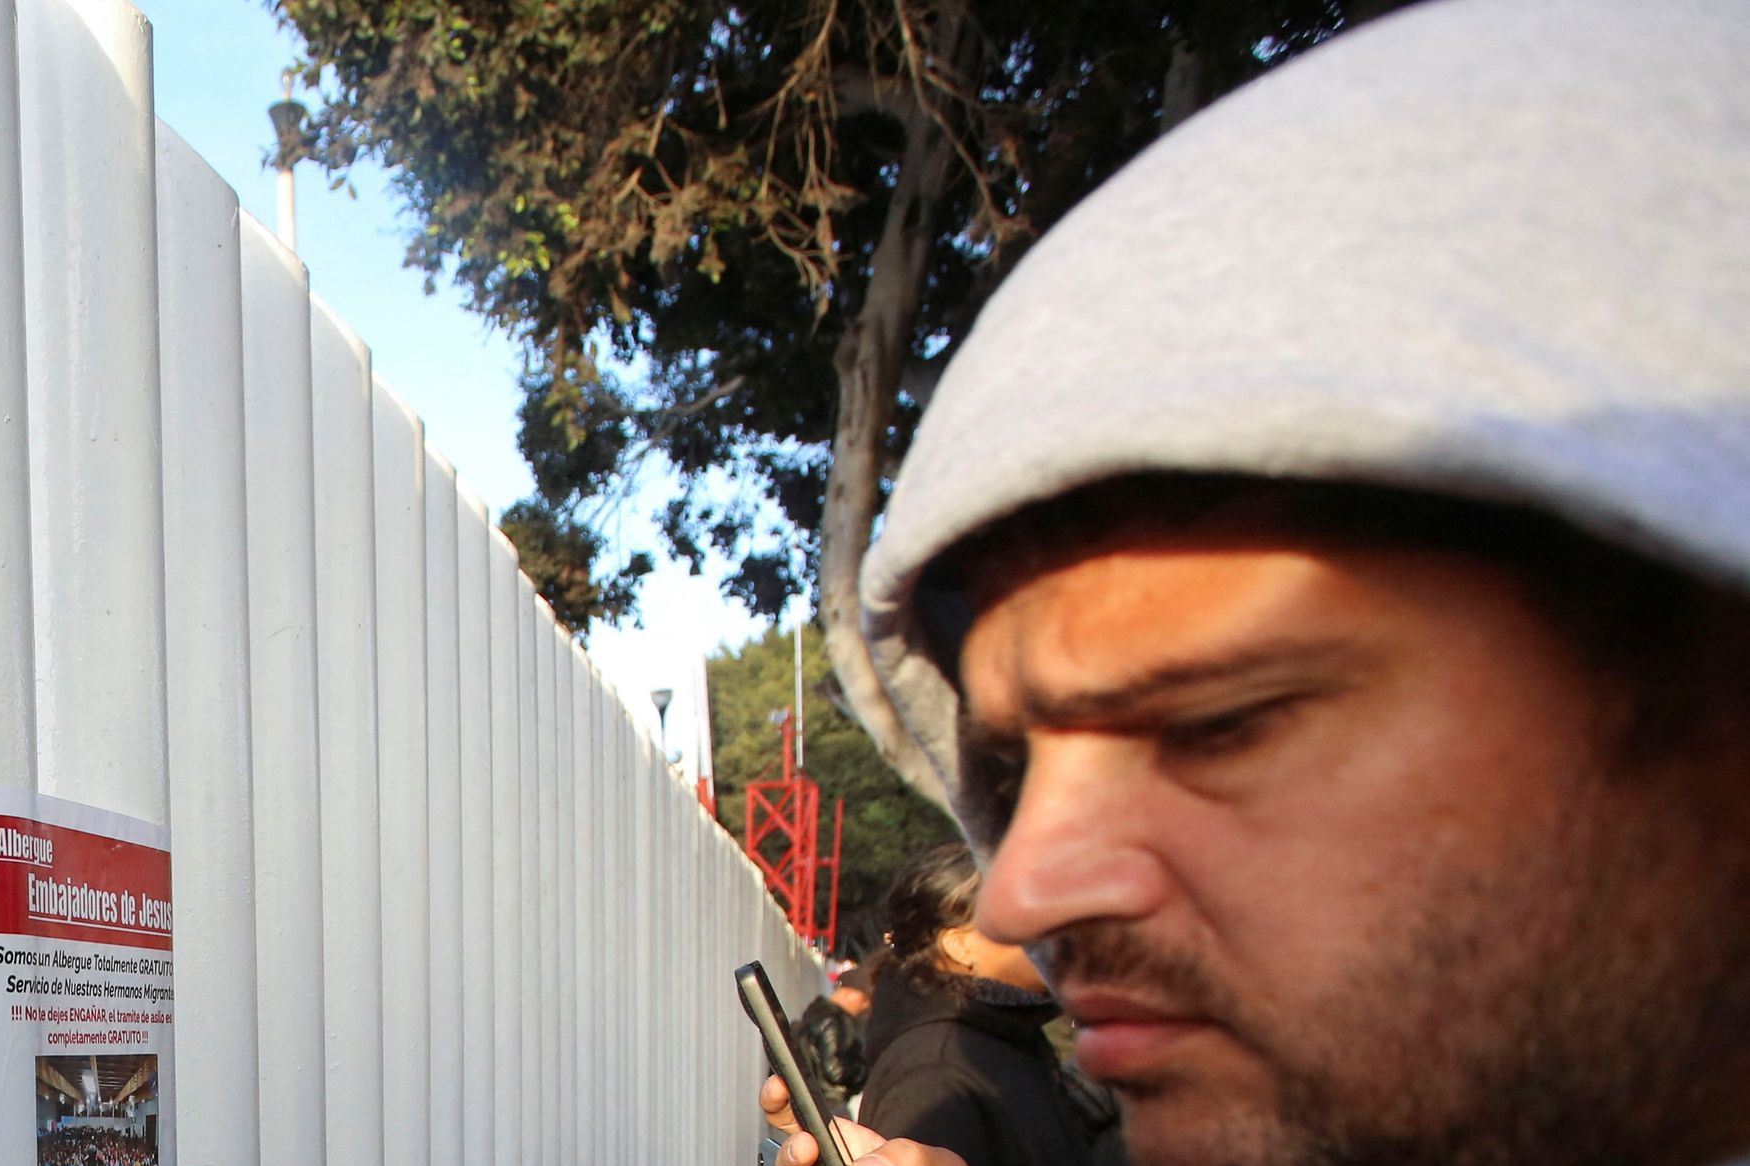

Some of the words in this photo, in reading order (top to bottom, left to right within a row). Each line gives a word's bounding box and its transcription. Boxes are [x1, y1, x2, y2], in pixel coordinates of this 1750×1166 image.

[28, 872, 117, 922] Embajadores
[120, 889, 136, 926] de
[139, 892, 172, 931] Jesus
[38, 952, 51, 967] un
[52, 950, 92, 974] Albergue
[93, 953, 138, 974] Totalmente
[139, 958, 174, 977] GRATUITO
[6, 974, 49, 995] Servicio
[51, 977, 63, 995] de
[64, 977, 102, 997] Nuestros
[103, 981, 143, 999] Hermanos
[11, 1005, 22, 1021] !!!
[25, 1006, 38, 1021] No
[47, 1006, 69, 1025] dejes
[108, 1008, 116, 1023] el
[117, 1009, 140, 1024] tramite
[140, 1010, 150, 1024] de
[150, 1010, 165, 1024] asilo
[47, 1029, 106, 1048] completamente
[107, 1029, 142, 1045] GRATUITO
